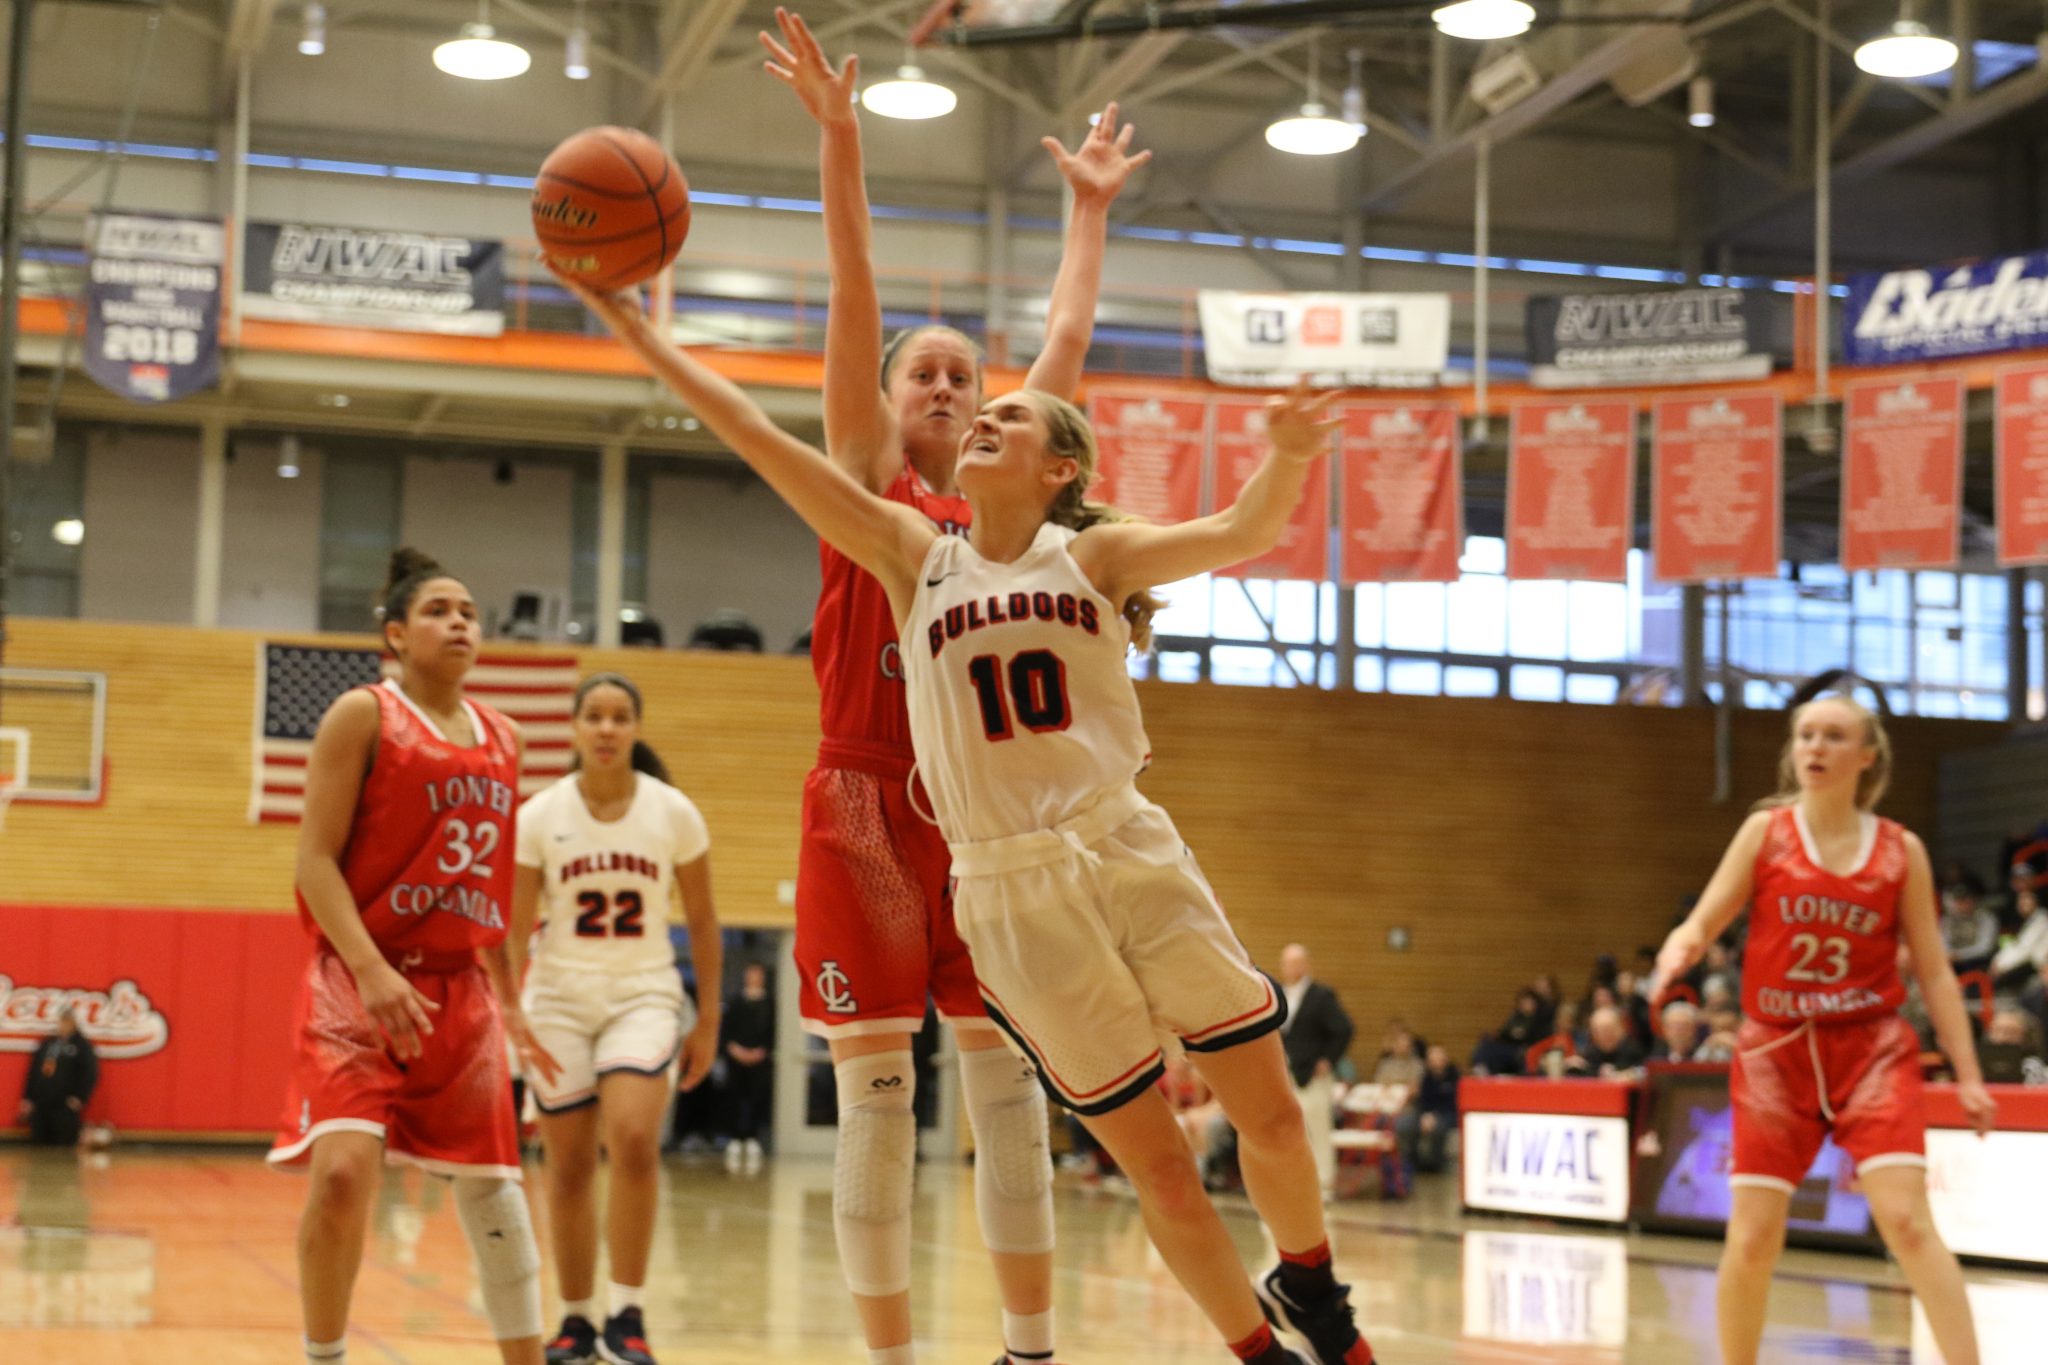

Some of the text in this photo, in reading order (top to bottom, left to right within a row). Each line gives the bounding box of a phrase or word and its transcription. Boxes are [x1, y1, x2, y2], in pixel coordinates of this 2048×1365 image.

[91, 258, 216, 291] CHAMPIONS
[272, 223, 471, 286] NWAC
[271, 277, 474, 314] CHAMPIONSHIP
[1555, 287, 1744, 342] NWAC
[1554, 337, 1747, 370] CHAMPIONSHIP
[927, 590, 1099, 659] BULLDOGS
[968, 648, 1072, 742] 10
[436, 819, 501, 879] 32
[560, 853, 660, 884] BULLDOGS
[574, 889, 645, 938] 22
[1784, 932, 1850, 985] 23
[1487, 1122, 1604, 1182] NWAC
